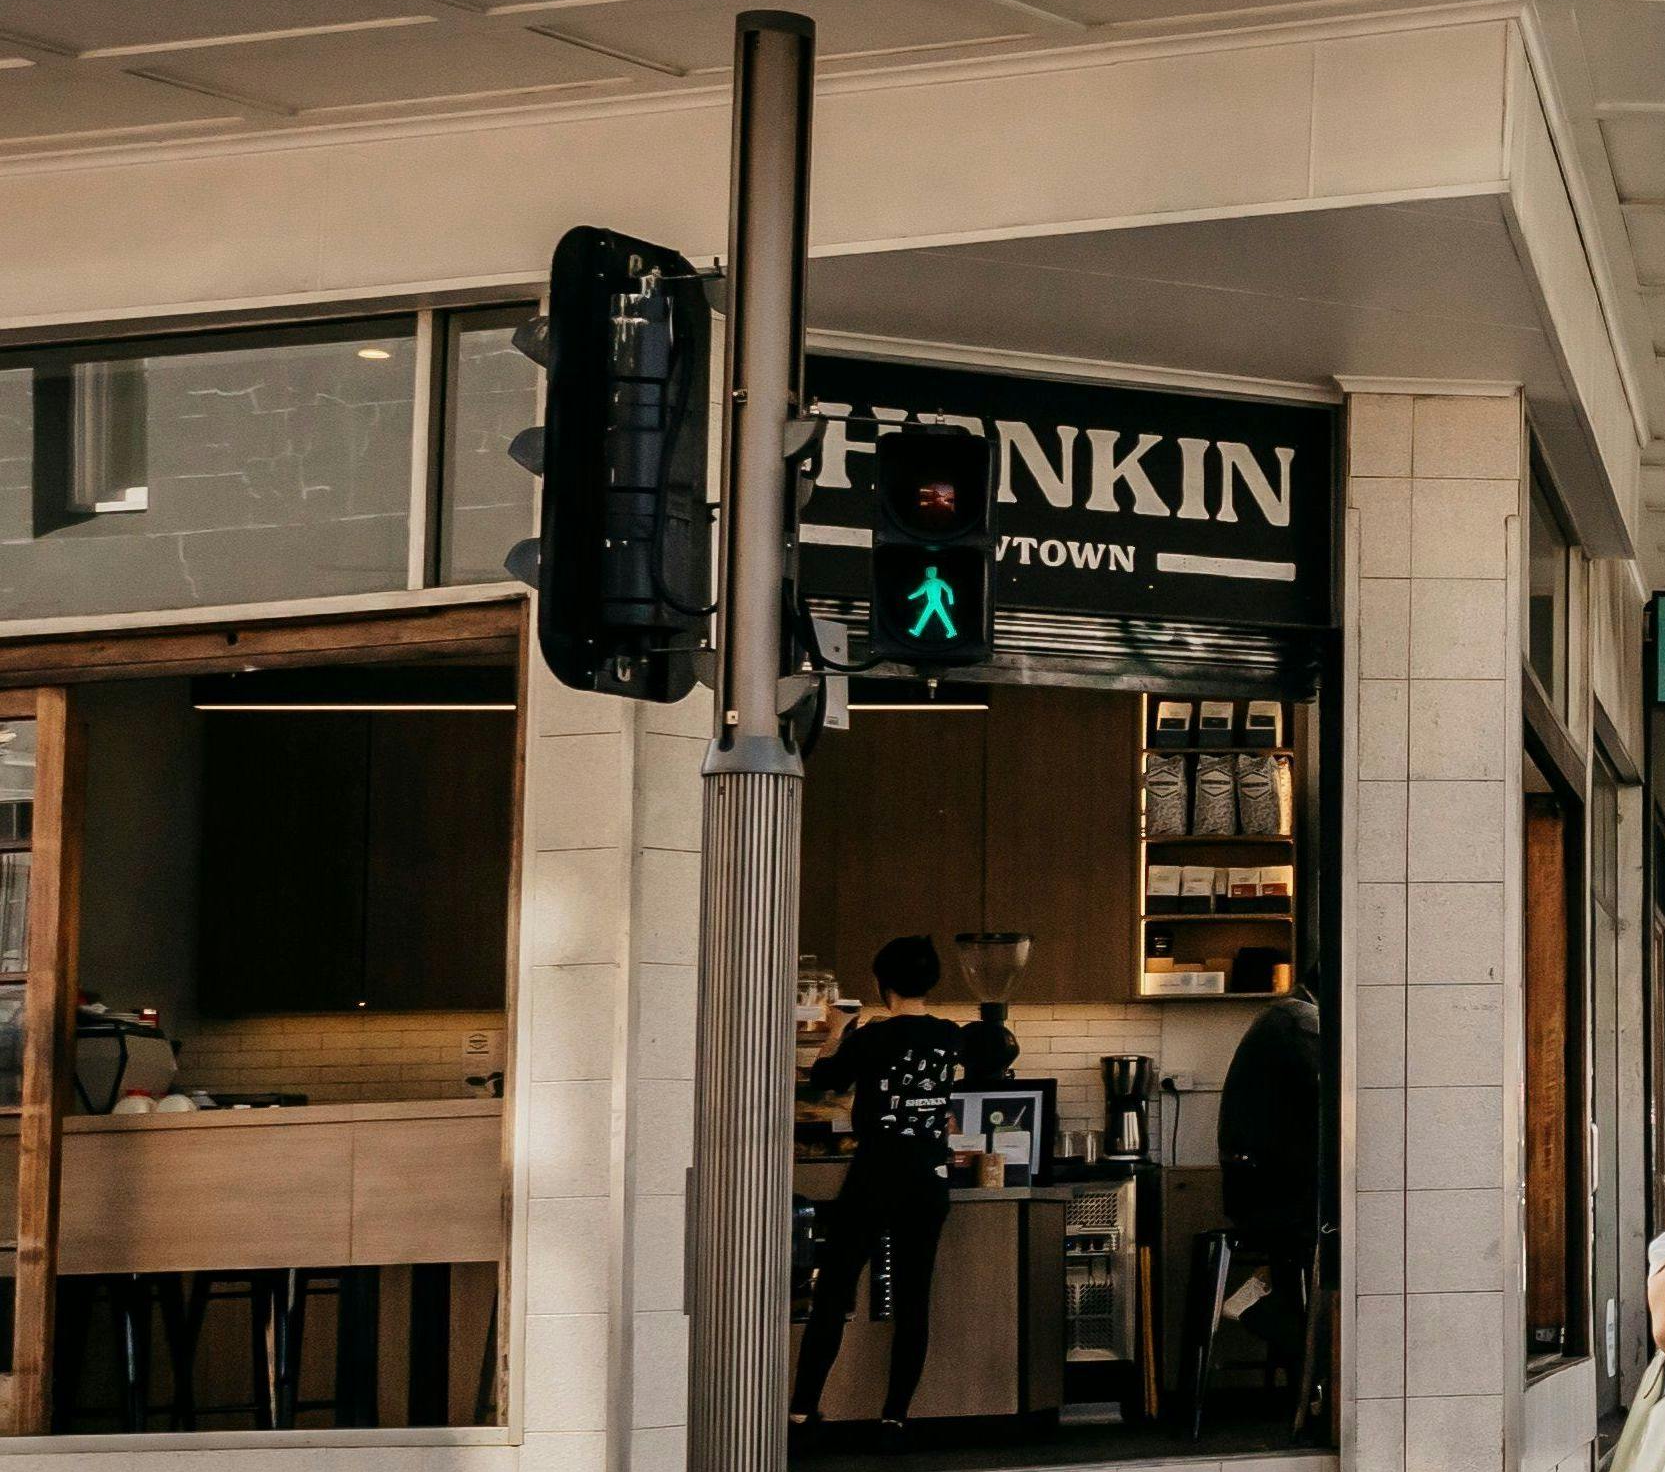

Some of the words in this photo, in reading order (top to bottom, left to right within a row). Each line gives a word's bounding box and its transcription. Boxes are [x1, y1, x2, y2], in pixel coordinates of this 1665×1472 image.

[812, 401, 1297, 527] HNKIN
[995, 534, 1136, 574] TOWN
[905, 1097, 947, 1107] SHENKIN
